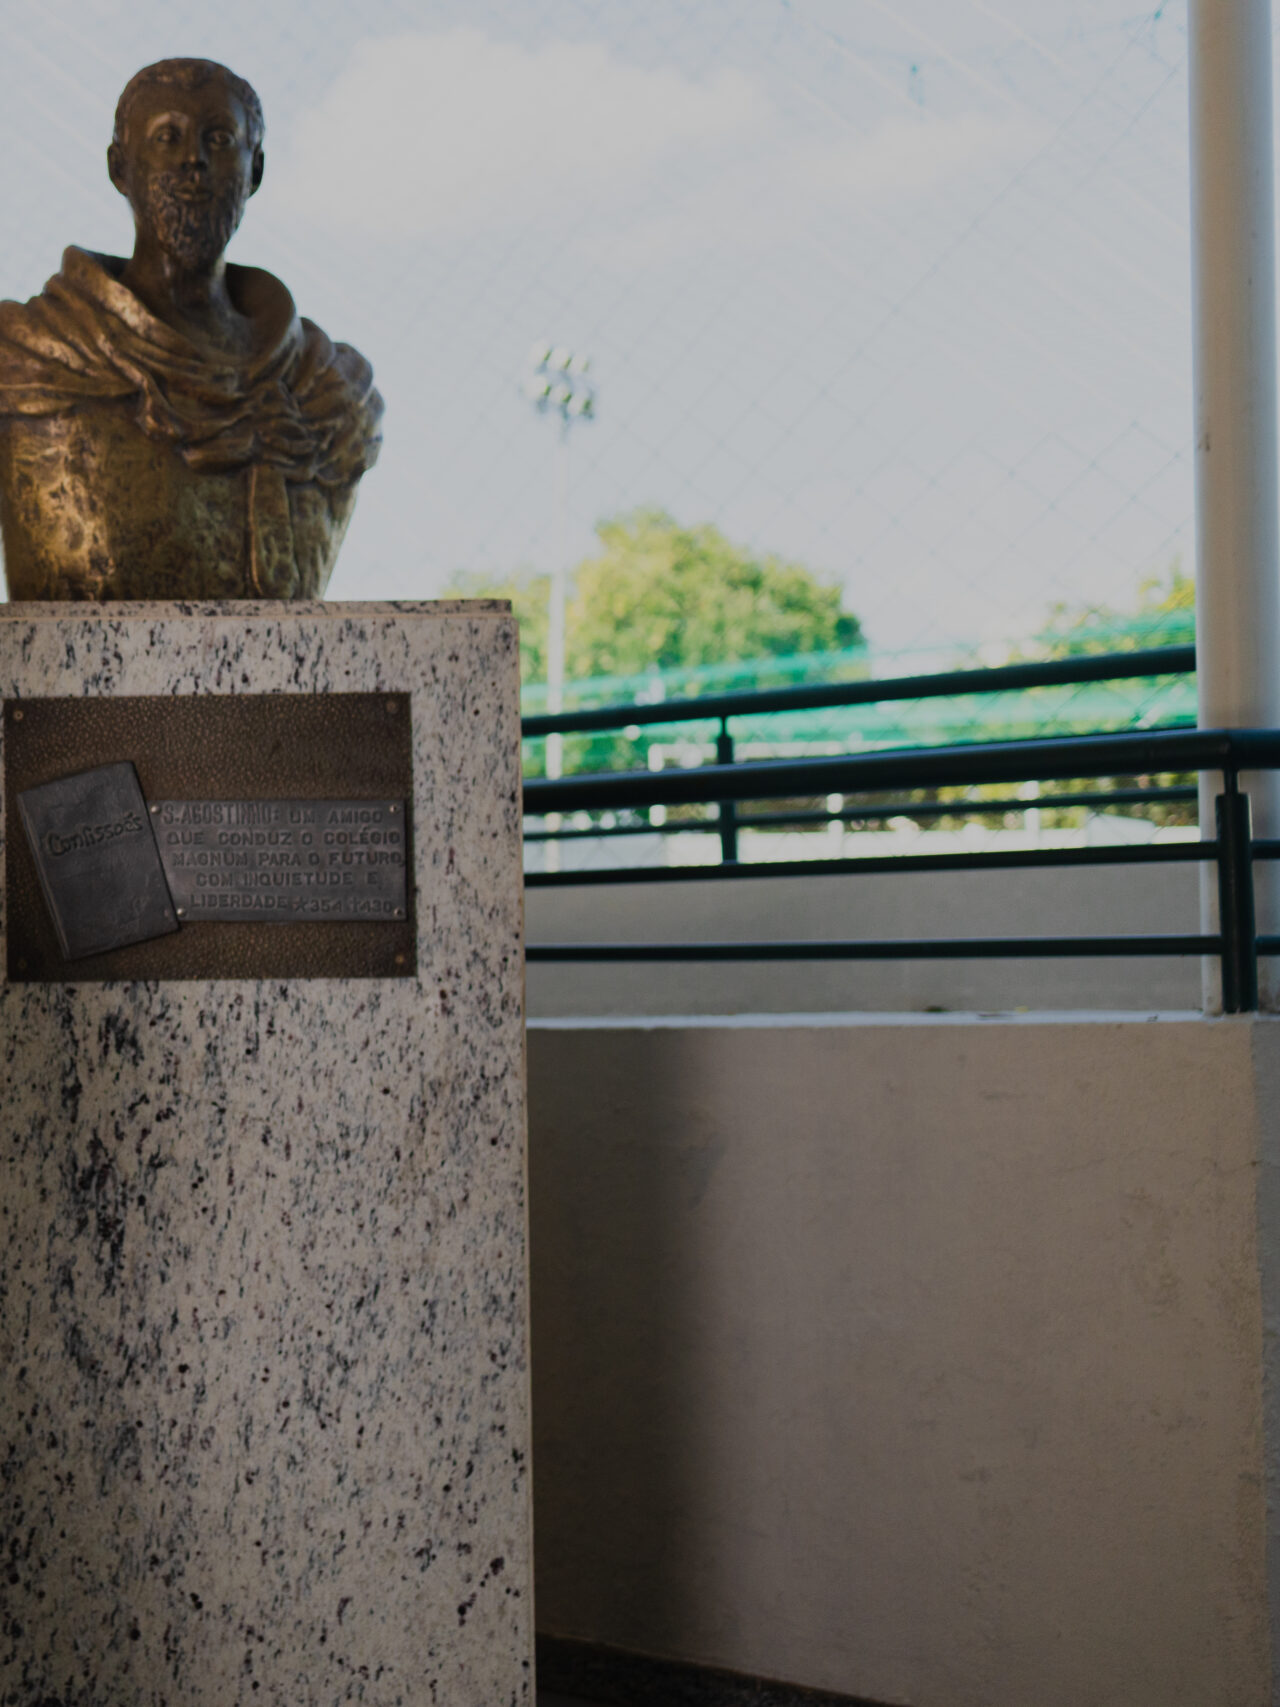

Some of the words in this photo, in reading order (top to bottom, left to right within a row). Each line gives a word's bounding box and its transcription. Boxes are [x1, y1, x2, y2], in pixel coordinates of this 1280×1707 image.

[289, 809, 315, 824] UM
[328, 810, 383, 824] AMIGO
[167, 832, 204, 845] QUE
[218, 832, 292, 845] CONDUZ
[302, 832, 313, 845] O
[324, 827, 401, 845] COLÉGIO
[172, 852, 248, 867] MAGNUM
[258, 853, 301, 866] PARA
[309, 852, 320, 865] O
[196, 873, 233, 887] COM
[244, 872, 353, 886] INQUIETUDE
[190, 894, 288, 909] LIBERDADE
